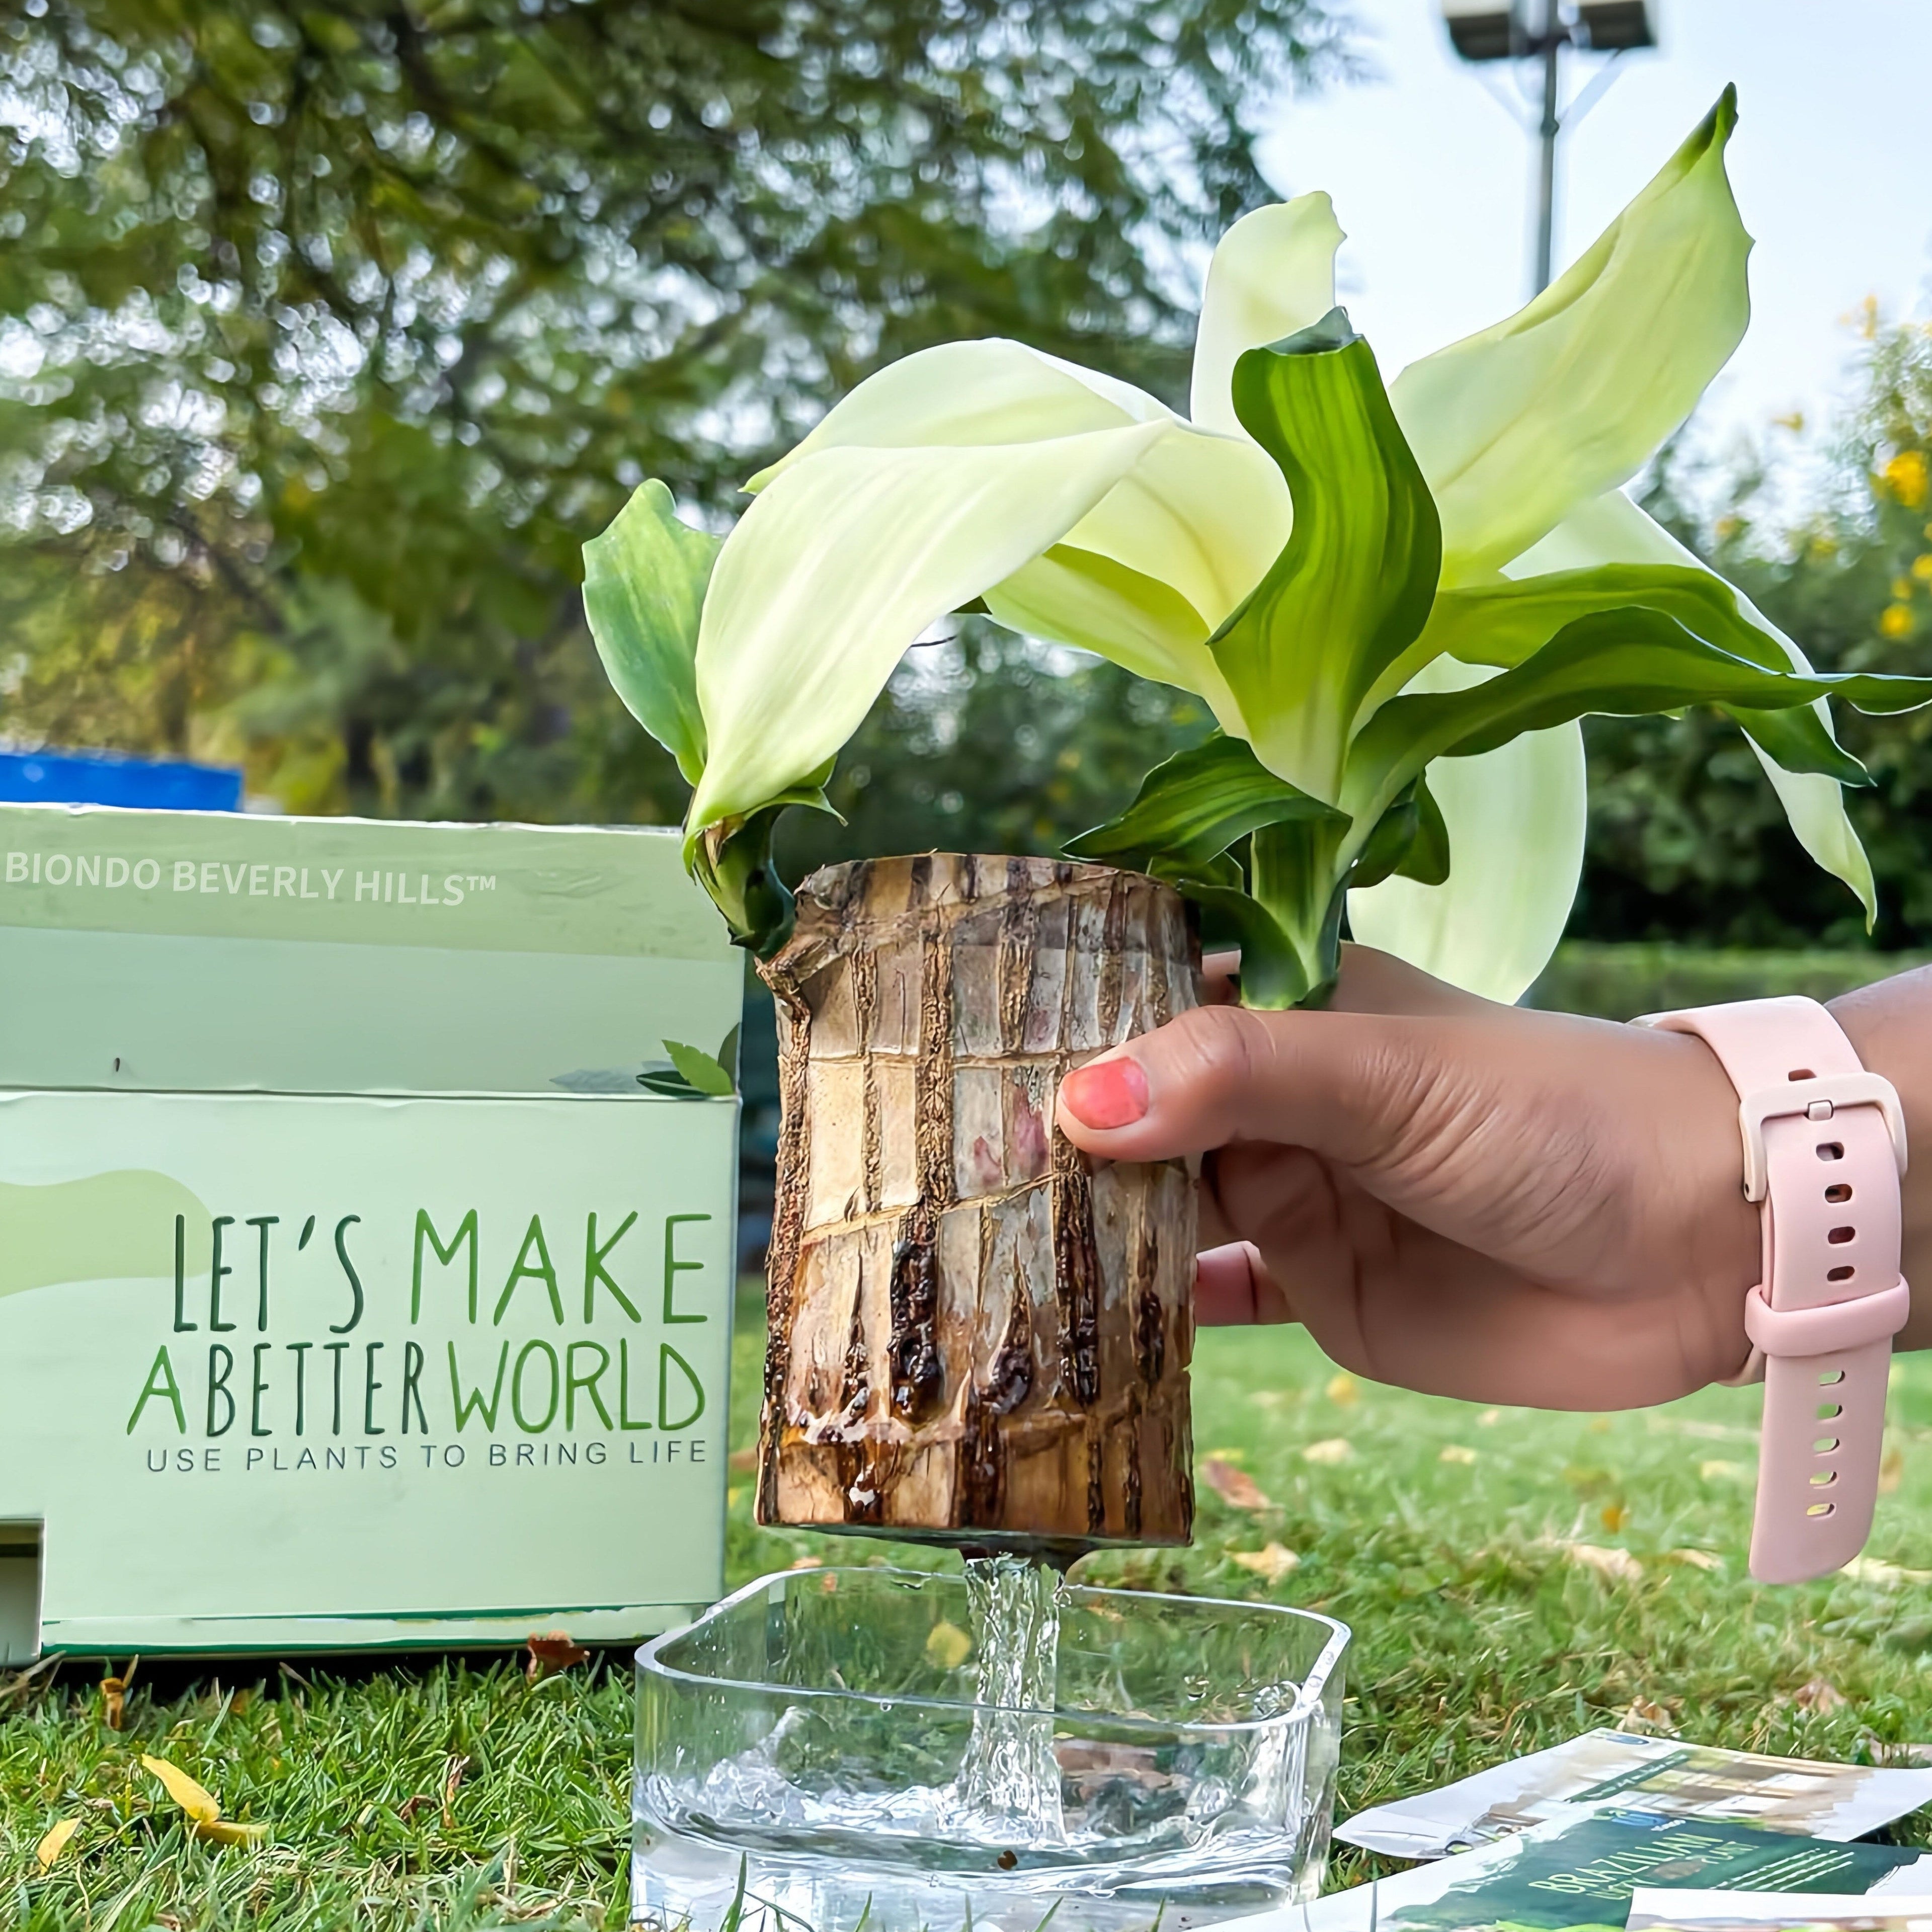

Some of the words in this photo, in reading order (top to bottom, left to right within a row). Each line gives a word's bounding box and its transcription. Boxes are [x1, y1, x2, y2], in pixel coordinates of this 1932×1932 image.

[6, 852, 160, 890] BIONDO
[173, 861, 345, 900] BEVERLY
[174, 1214, 364, 1334] LET'S
[411, 1209, 712, 1327] MAKE
[126, 1345, 186, 1436] A
[206, 1341, 429, 1438] BETTER
[447, 1337, 705, 1434] WORLD
[147, 1448, 221, 1473] USE
[247, 1445, 397, 1471] PLANTS
[420, 1444, 465, 1468] TO
[489, 1442, 607, 1467] BRING
[630, 1440, 705, 1464] LIFE
[1527, 1832, 1723, 1894] BRAZILIAN
